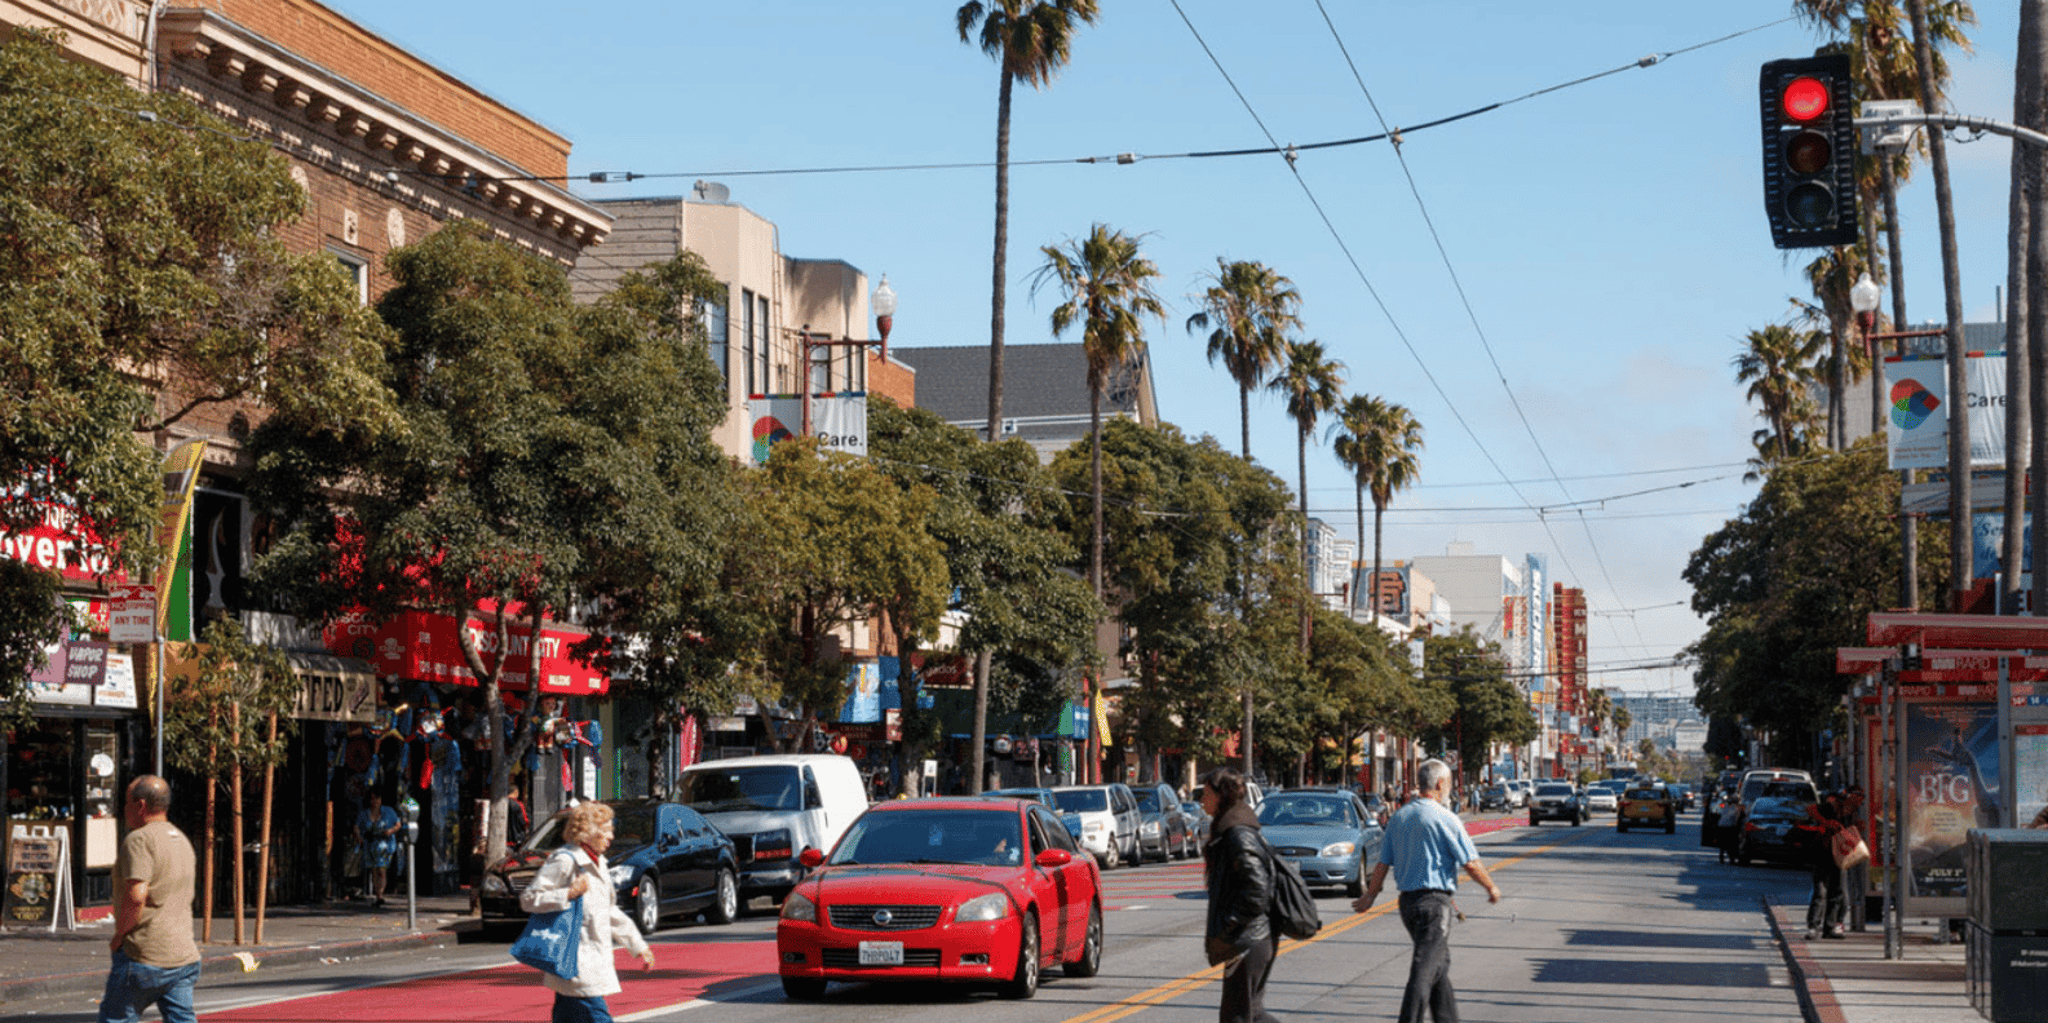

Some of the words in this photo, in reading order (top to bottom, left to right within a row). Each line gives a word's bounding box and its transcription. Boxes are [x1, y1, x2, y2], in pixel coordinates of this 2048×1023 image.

[818, 431, 863, 447] Care.
[114, 616, 130, 625] ANY
[132, 616, 151, 625] TIME
[347, 624, 378, 635] CITY
[67, 663, 99, 679] SHOP
[1919, 773, 1970, 804] BFG
[1928, 868, 1950, 877] JULY
